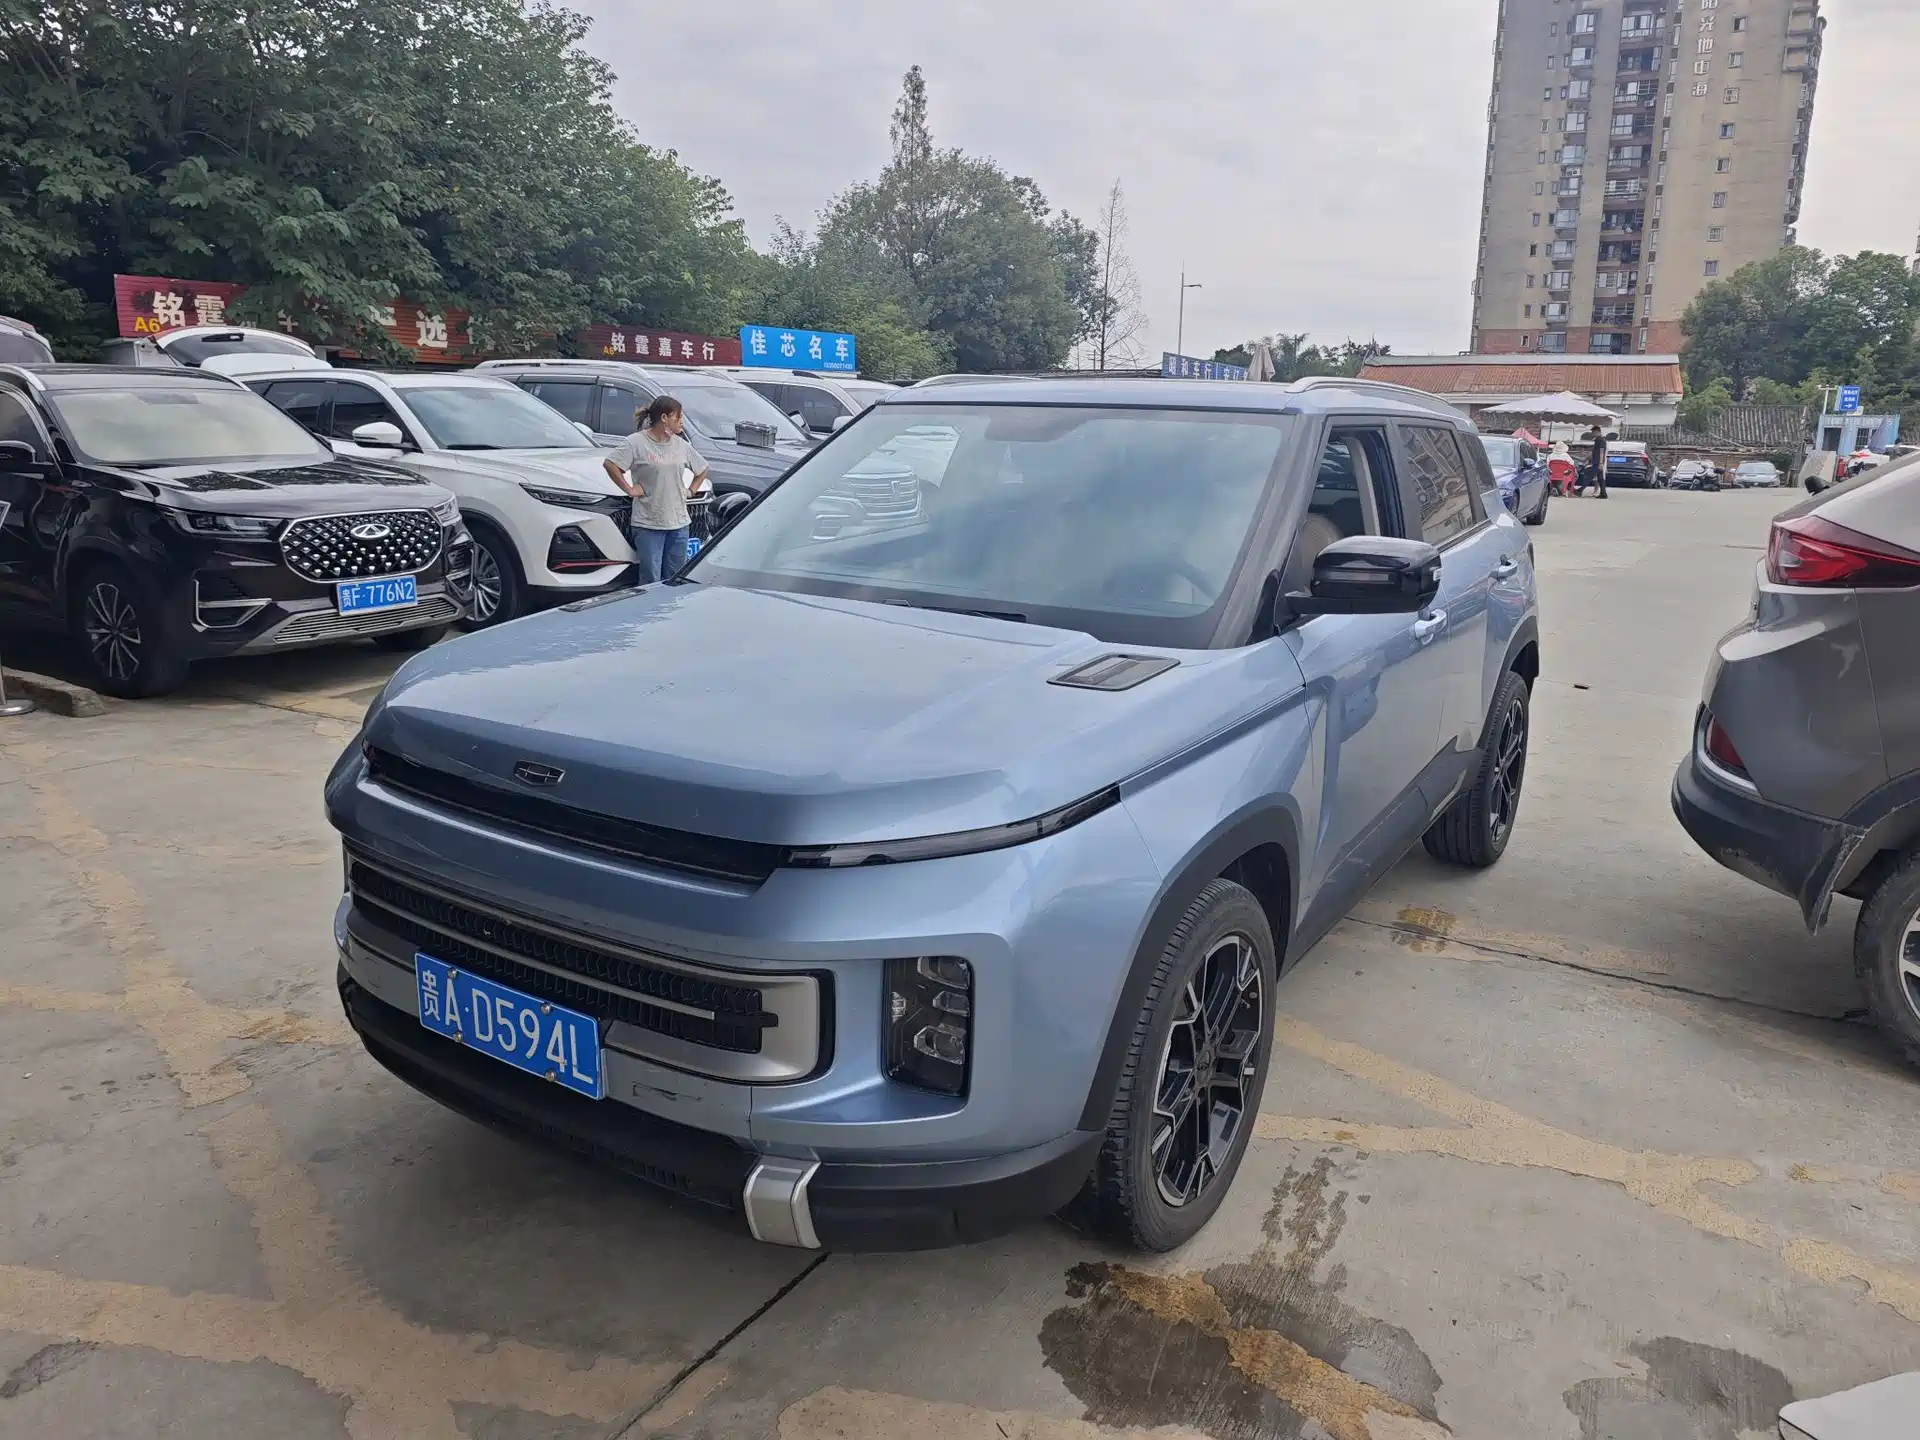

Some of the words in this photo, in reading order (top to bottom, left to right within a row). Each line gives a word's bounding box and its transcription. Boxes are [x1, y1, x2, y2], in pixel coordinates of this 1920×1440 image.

[134, 316, 161, 333] A6
[750, 329, 849, 361] 佳芯名车
[421, 970, 594, 1085] 贵A·D594L
